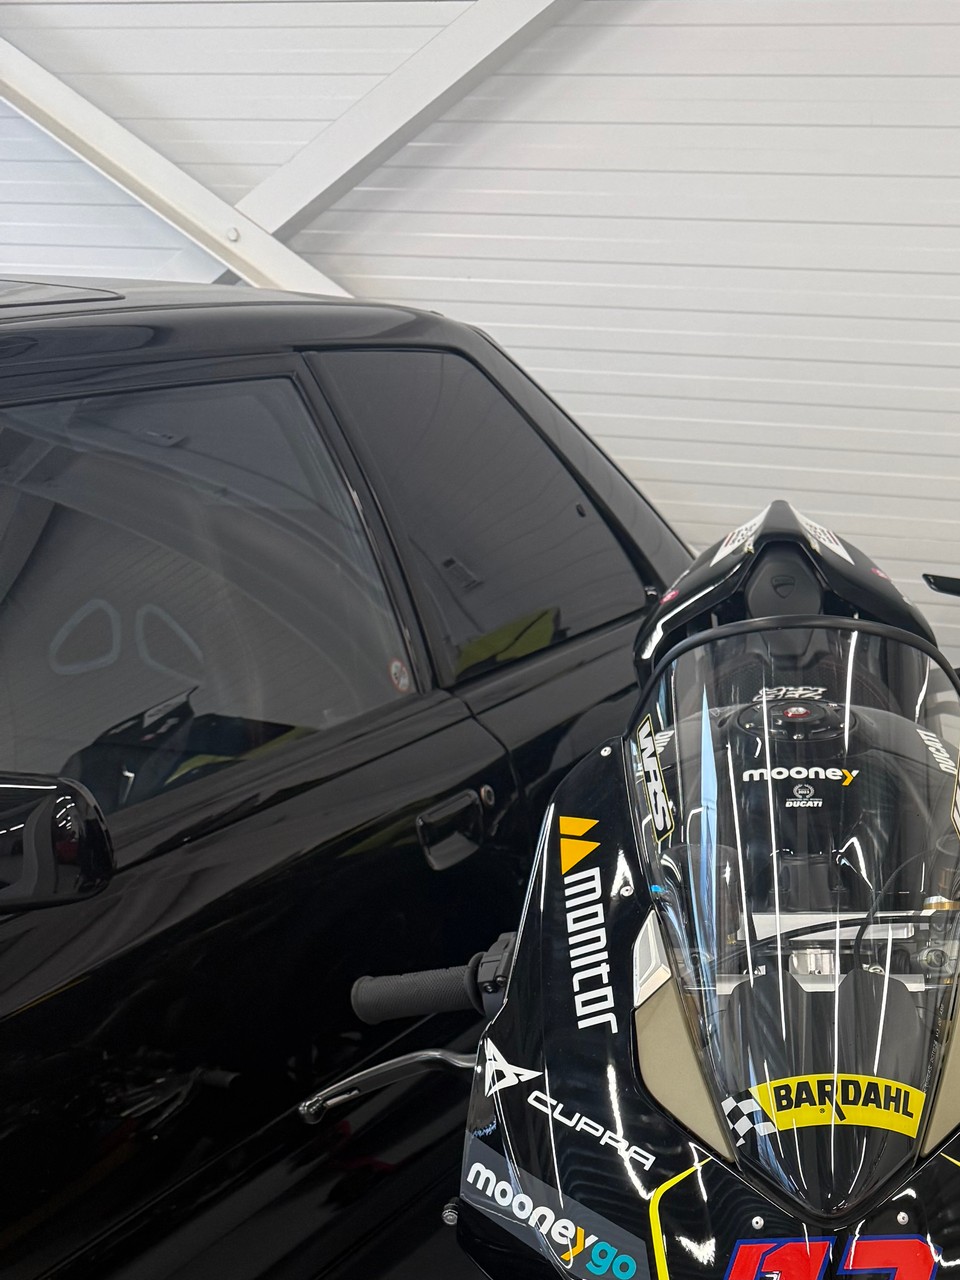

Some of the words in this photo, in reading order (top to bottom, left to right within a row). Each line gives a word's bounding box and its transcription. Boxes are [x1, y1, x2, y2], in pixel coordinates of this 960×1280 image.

[638, 719, 672, 831] WRS
[742, 766, 860, 786] mooney
[563, 866, 619, 1034] monitor
[527, 1090, 657, 1171] CUPRA
[773, 1079, 914, 1121] BARDAHL
[466, 1162, 637, 1280] mooneygo
